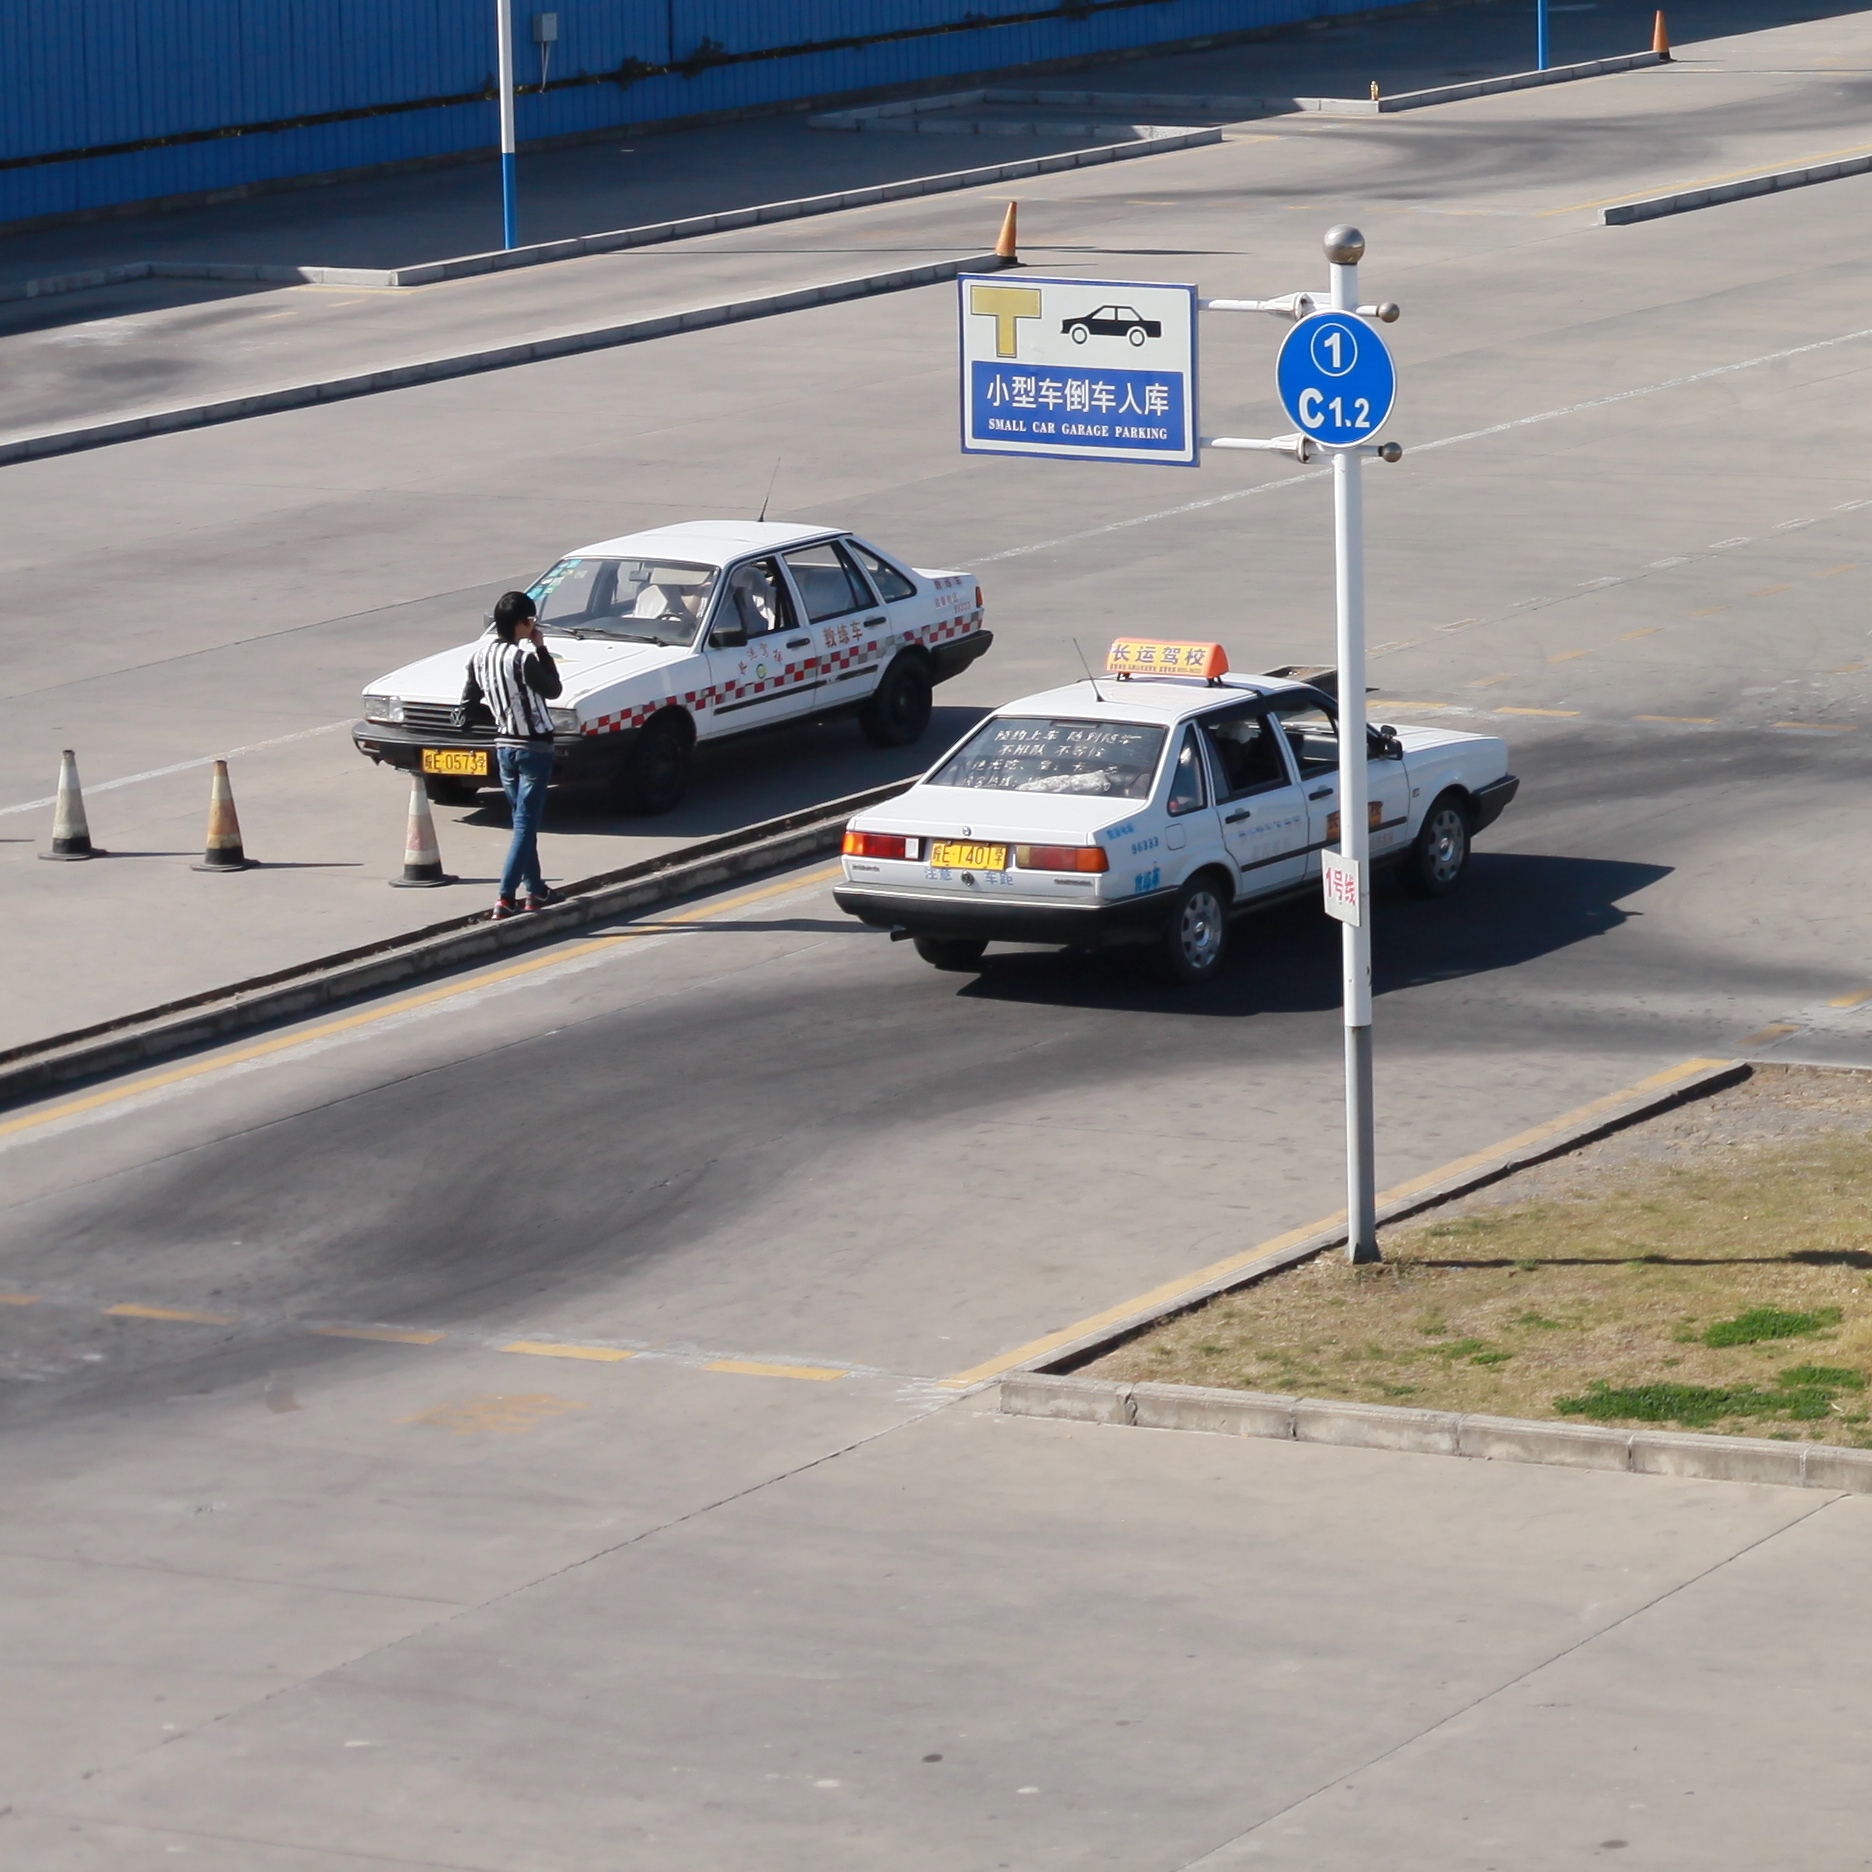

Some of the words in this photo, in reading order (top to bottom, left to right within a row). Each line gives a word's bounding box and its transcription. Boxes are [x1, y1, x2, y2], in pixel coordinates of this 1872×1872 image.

[986, 374, 1170, 418] 小型车倒车入库
[1299, 387, 1371, 429] C1.2
[988, 417, 1027, 434] SMALL
[1032, 420, 1055, 435] CAR
[1061, 422, 1109, 438] GARAGE
[1115, 425, 1168, 441] PARKING
[1112, 643, 1206, 666] 长运驾校
[924, 867, 953, 881] 注意
[1325, 867, 1356, 906] 1号线
